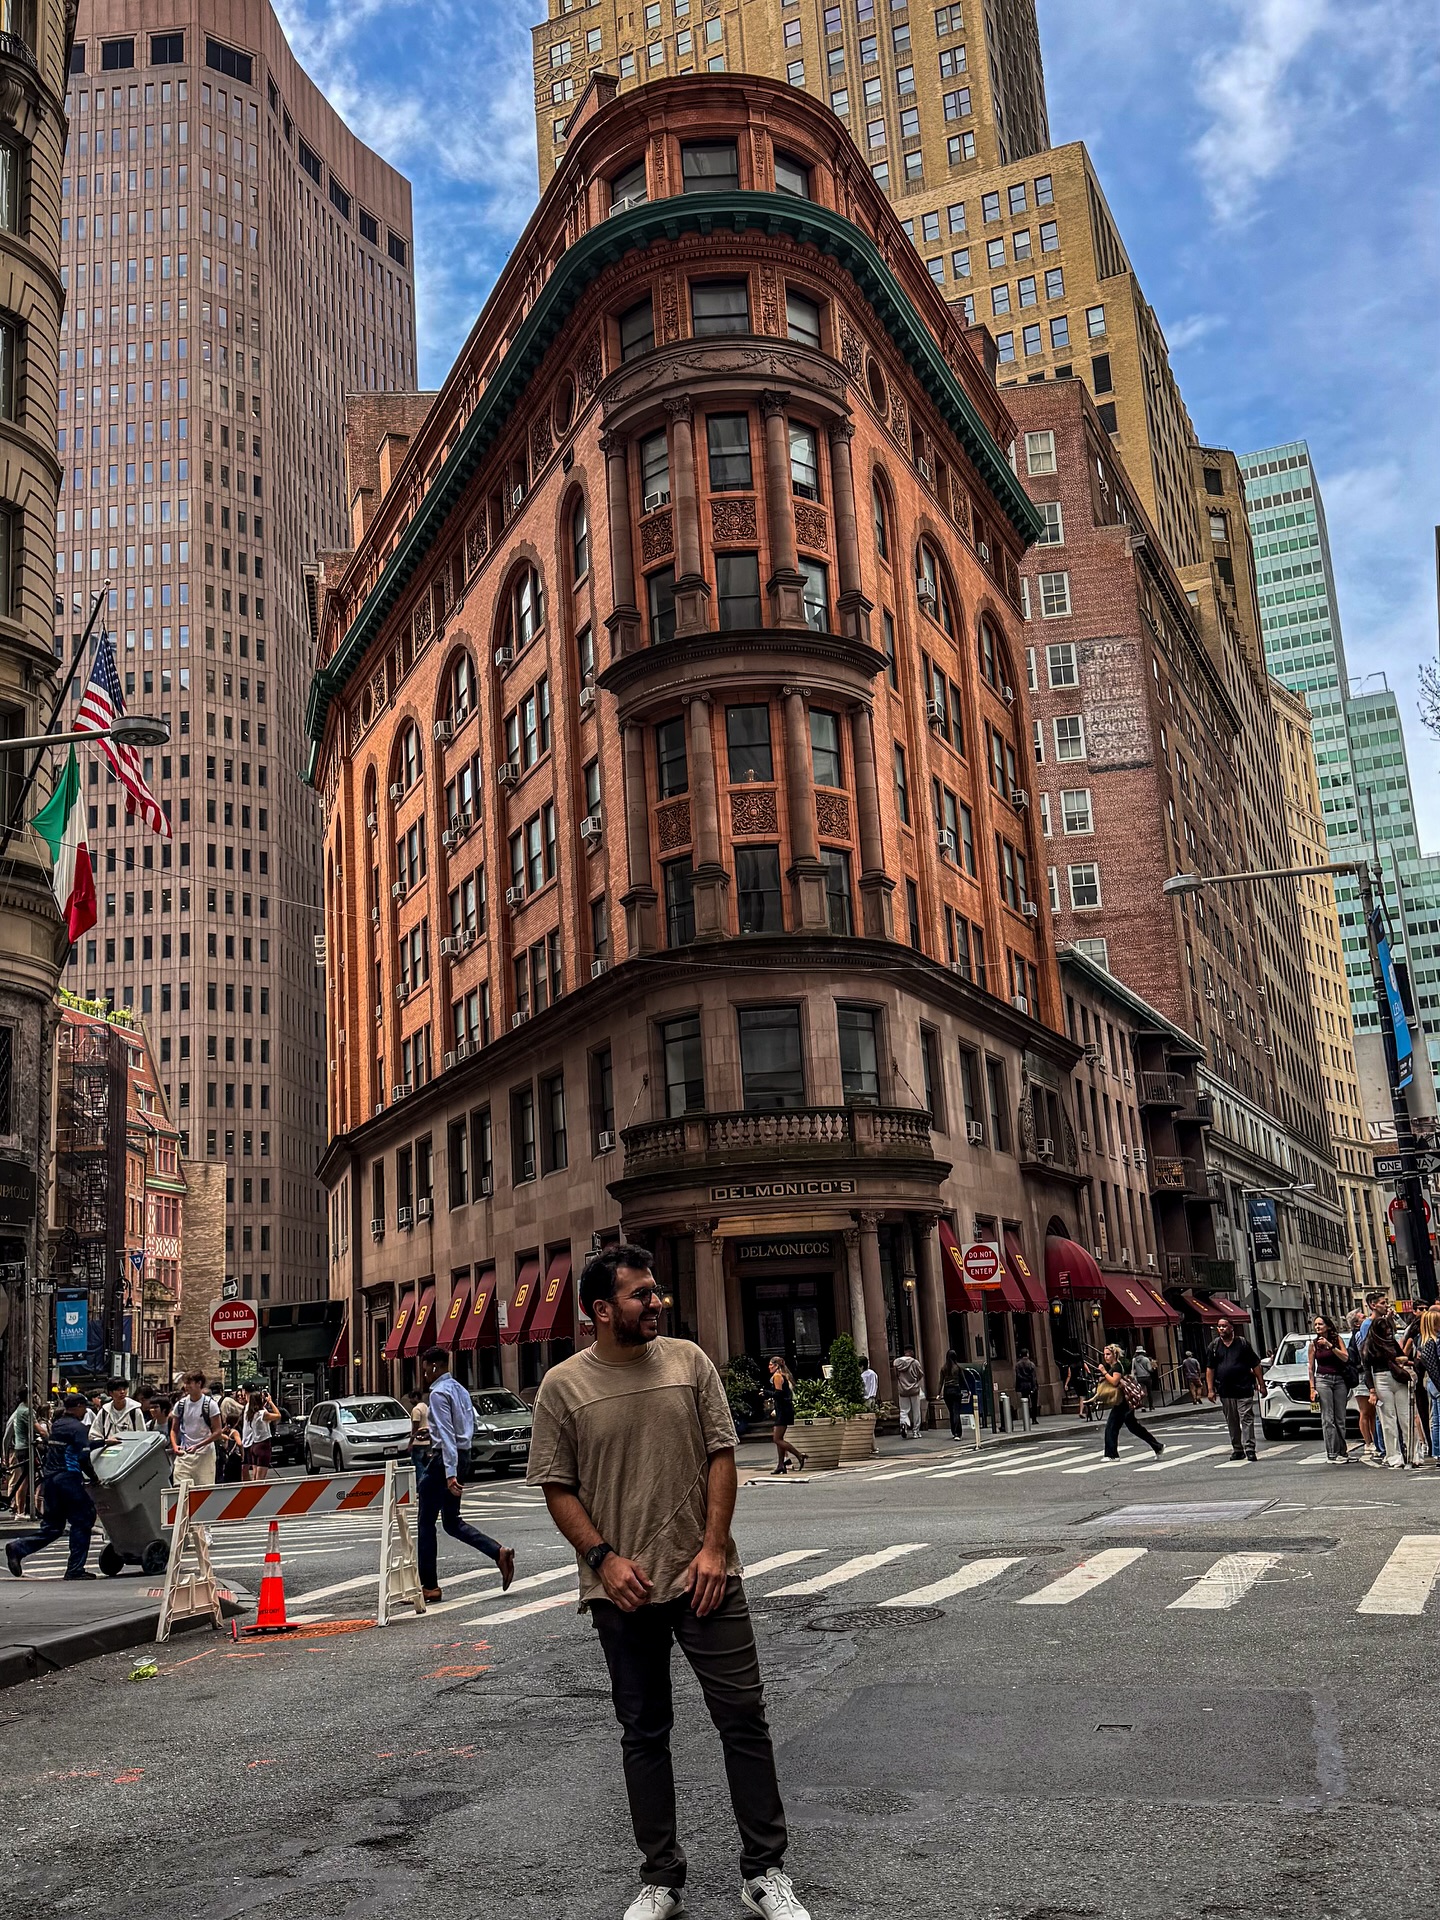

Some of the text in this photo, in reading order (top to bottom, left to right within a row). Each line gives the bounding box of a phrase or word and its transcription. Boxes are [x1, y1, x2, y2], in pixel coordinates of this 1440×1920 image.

[1380, 1161, 1401, 1171] ONE
[714, 1181, 852, 1200] DELMONICO'S
[740, 1242, 830, 1259] DELMONICOS
[968, 1251, 978, 1259] DO
[979, 1250, 992, 1258] NOT
[970, 1267, 993, 1276] ENTER
[218, 1309, 249, 1319] DO NOT
[221, 1330, 248, 1340] ENTER
